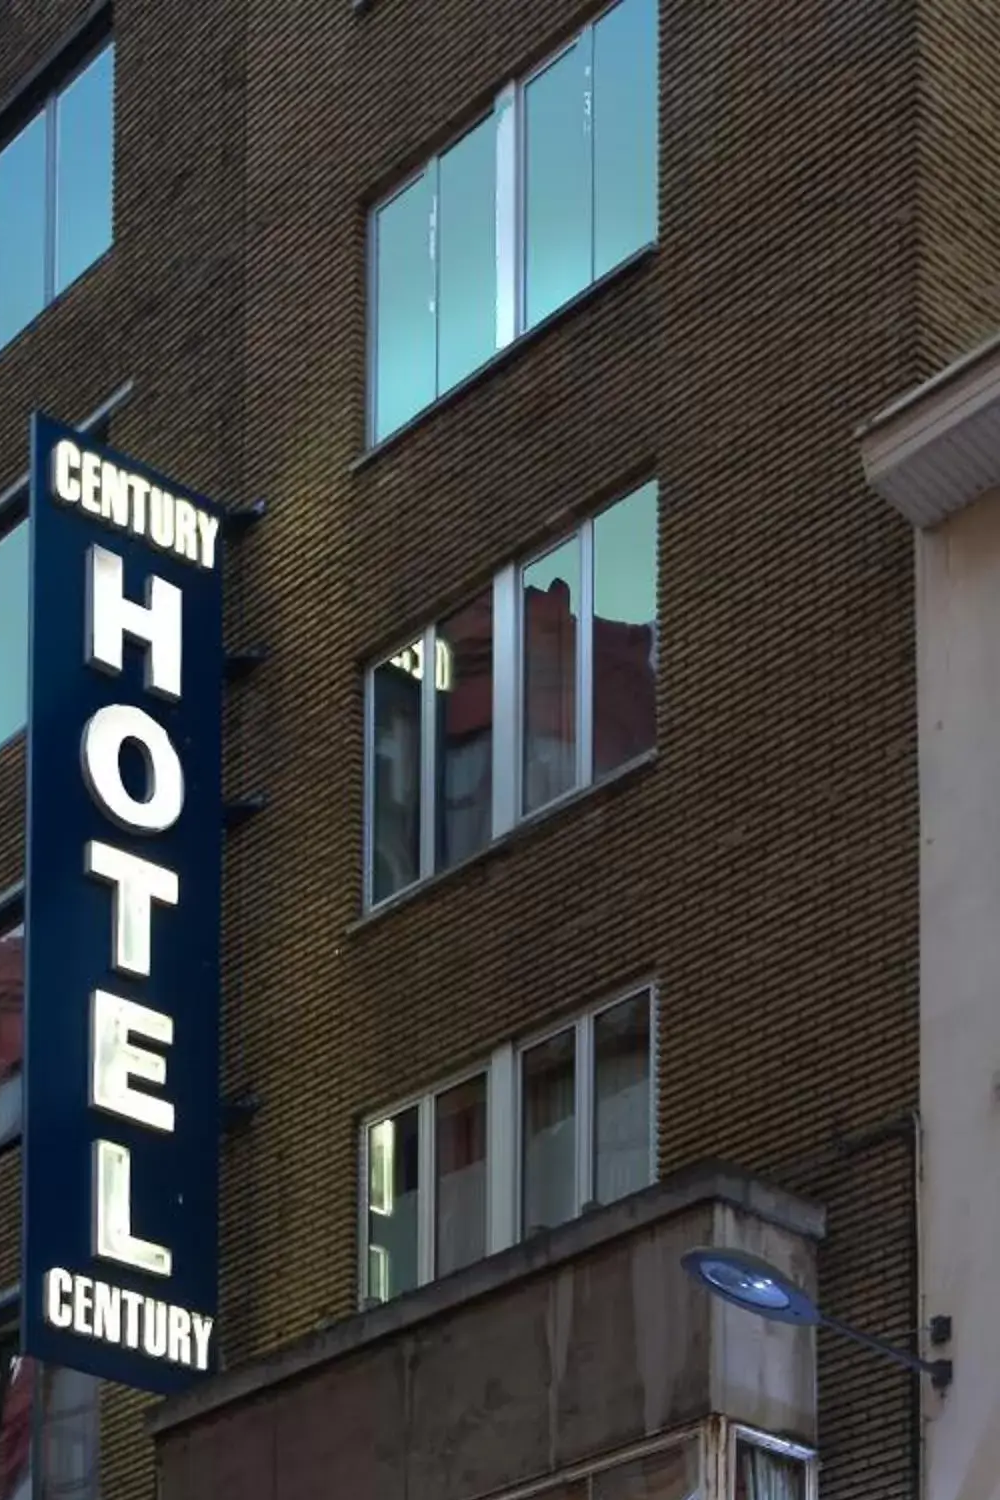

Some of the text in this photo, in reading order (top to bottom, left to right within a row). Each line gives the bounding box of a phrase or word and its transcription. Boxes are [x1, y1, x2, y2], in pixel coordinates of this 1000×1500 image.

[50, 439, 219, 569] CENTURY
[81, 543, 186, 1277] HOTEL
[44, 1267, 214, 1370] CENTURY
